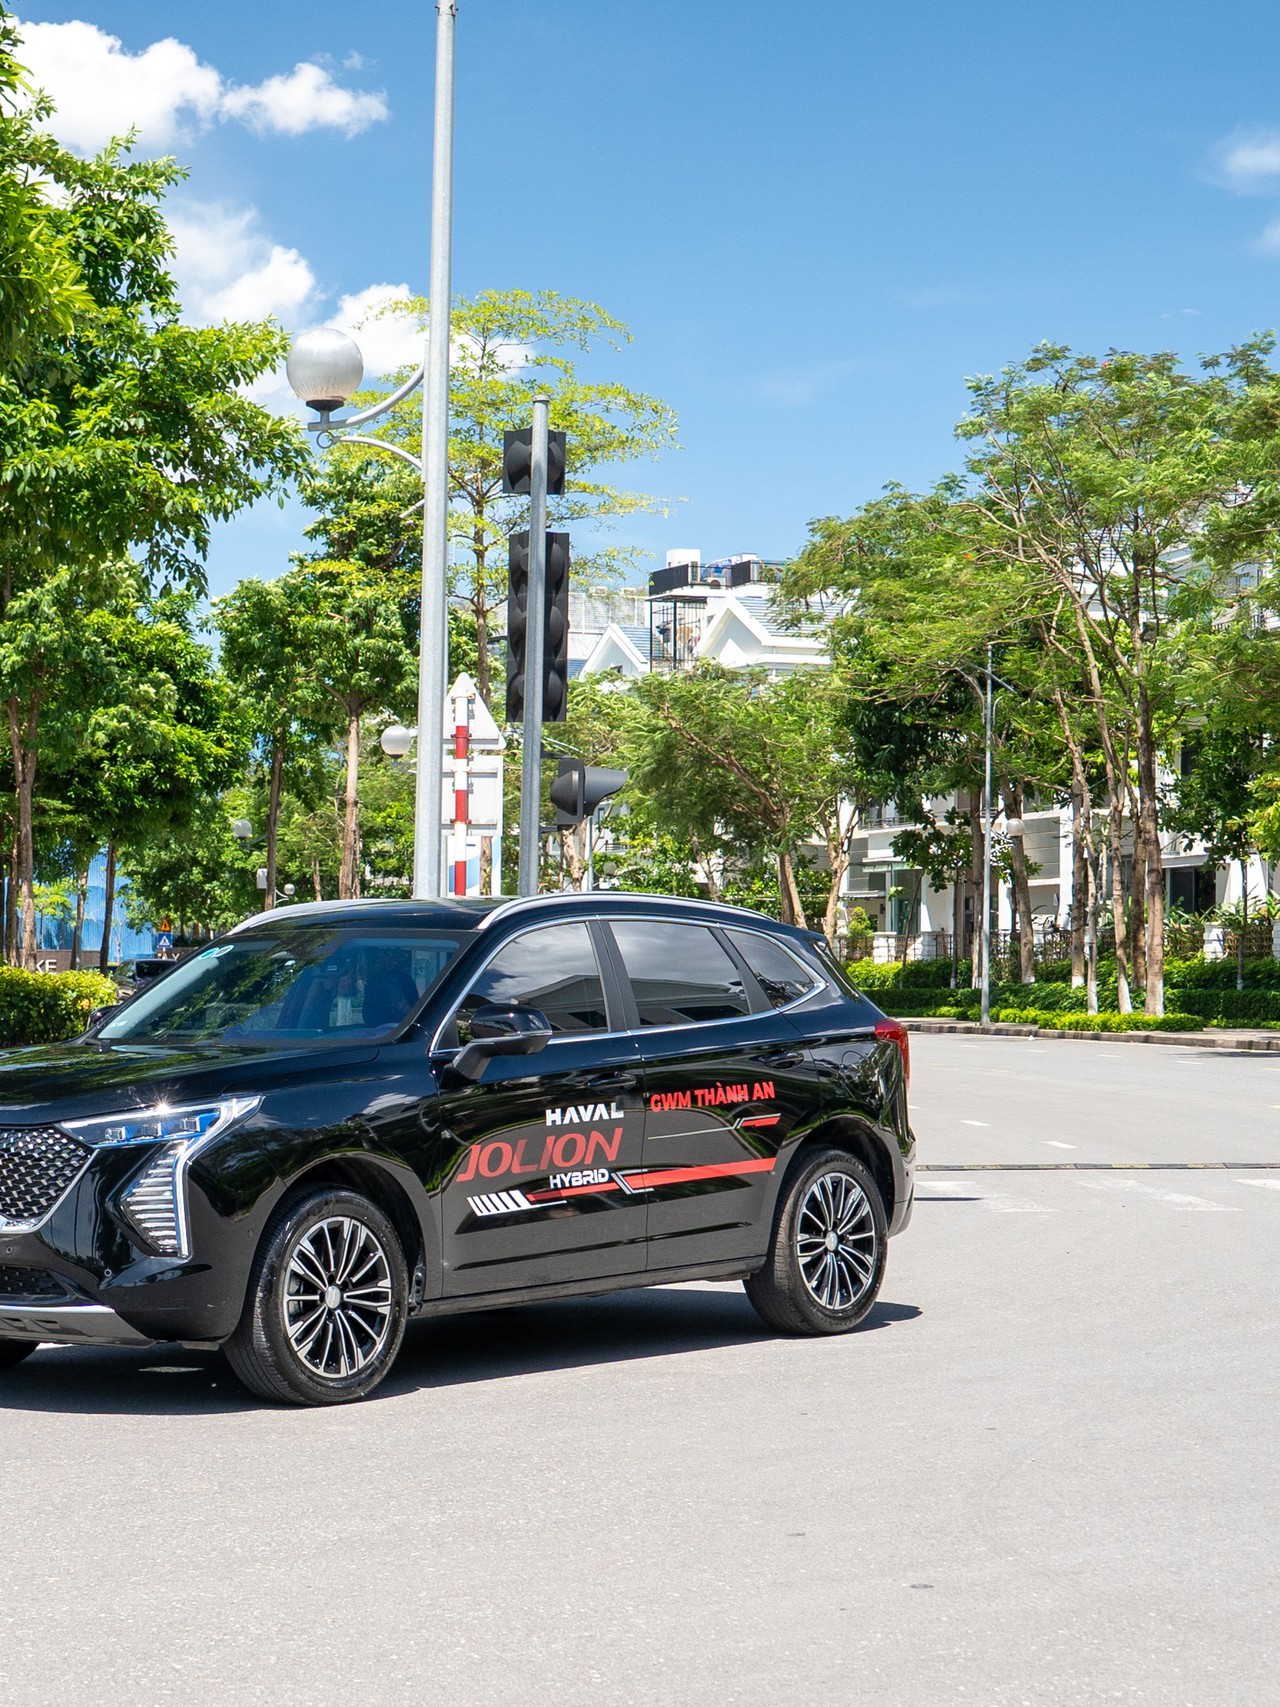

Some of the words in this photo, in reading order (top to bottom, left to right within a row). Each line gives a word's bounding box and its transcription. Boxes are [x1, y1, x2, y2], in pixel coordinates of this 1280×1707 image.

[650, 1091, 691, 1113] GWM
[694, 1082, 749, 1107] THÀNH
[752, 1081, 775, 1101] AN
[545, 1102, 624, 1126] HAVAL
[456, 1127, 624, 1183] JOLION
[549, 1168, 609, 1189] HYBRID
